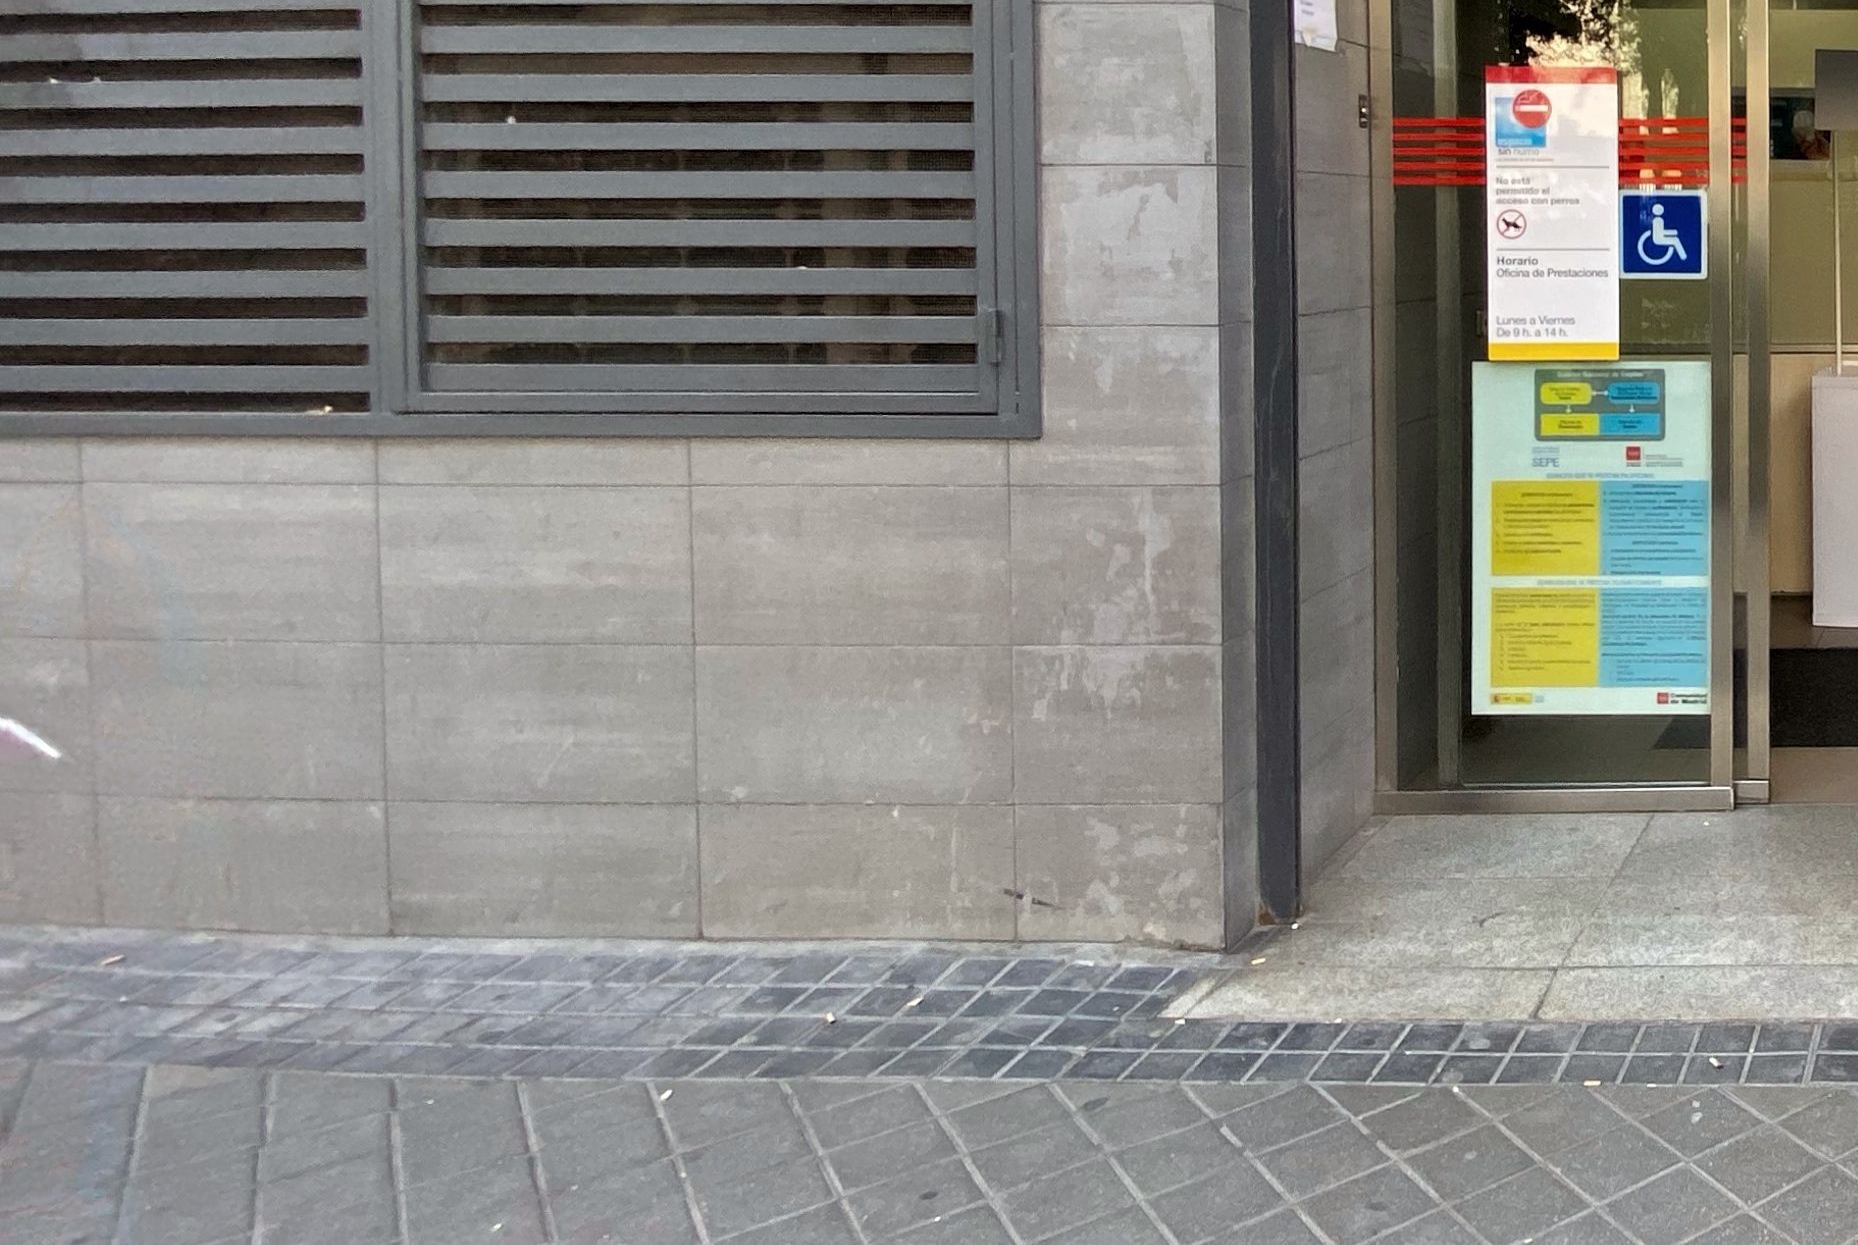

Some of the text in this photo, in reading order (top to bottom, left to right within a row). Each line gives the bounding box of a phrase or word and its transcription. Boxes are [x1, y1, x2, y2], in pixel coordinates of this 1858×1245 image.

[1496, 177, 1509, 185] No
[1496, 186, 1550, 196] permitido el
[1550, 198, 1580, 206] perros
[1496, 256, 1539, 266] Horario
[1496, 267, 1609, 278] Oficina de Prestaciones
[1496, 315, 1527, 325] Lunes
[1538, 315, 1576, 325] Viernes
[1496, 328, 1511, 337] De
[1522, 328, 1532, 337] h.
[1545, 328, 1557, 337] 14
[1559, 328, 1568, 337] h.
[1532, 458, 1559, 467] SEPE
